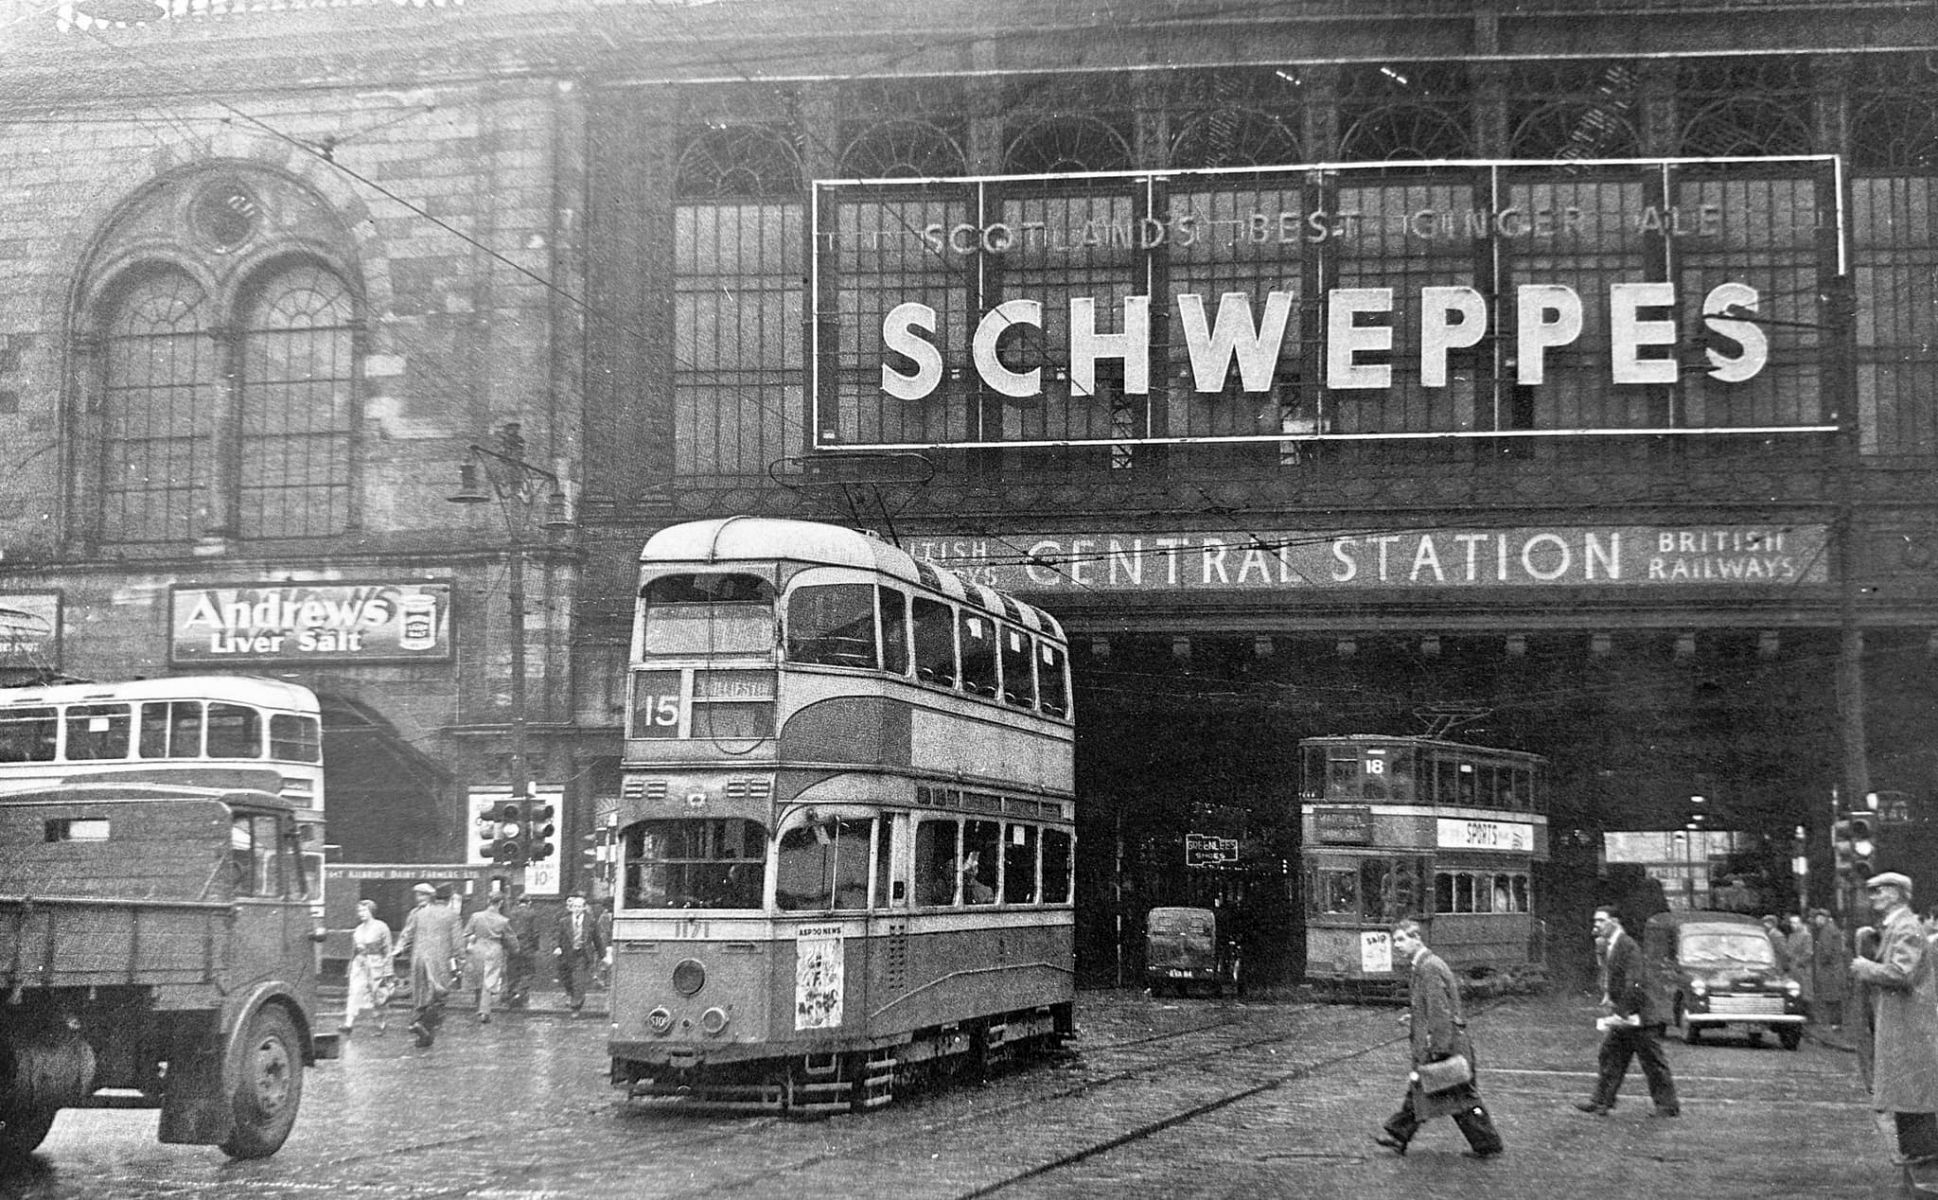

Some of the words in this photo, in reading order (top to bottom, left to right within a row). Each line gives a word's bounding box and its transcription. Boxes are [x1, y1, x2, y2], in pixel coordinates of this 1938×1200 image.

[1251, 209, 1361, 245] BEST
[1411, 205, 1583, 239] GINGER
[1640, 204, 1723, 237] ALE
[881, 282, 1769, 401] SCHWEPPES
[910, 540, 988, 564] ITISH
[1658, 530, 1784, 554] BRITISH
[1025, 536, 1302, 587] CENTRAL
[1331, 532, 1621, 582] STATION
[1648, 556, 1795, 581] RAILWAYS
[184, 592, 390, 630] Andrews
[210, 632, 284, 653] Liver
[298, 630, 362, 651] Salt
[645, 695, 679, 726] 15
[1365, 759, 1385, 774] 18
[1466, 822, 1498, 846] SPORTS
